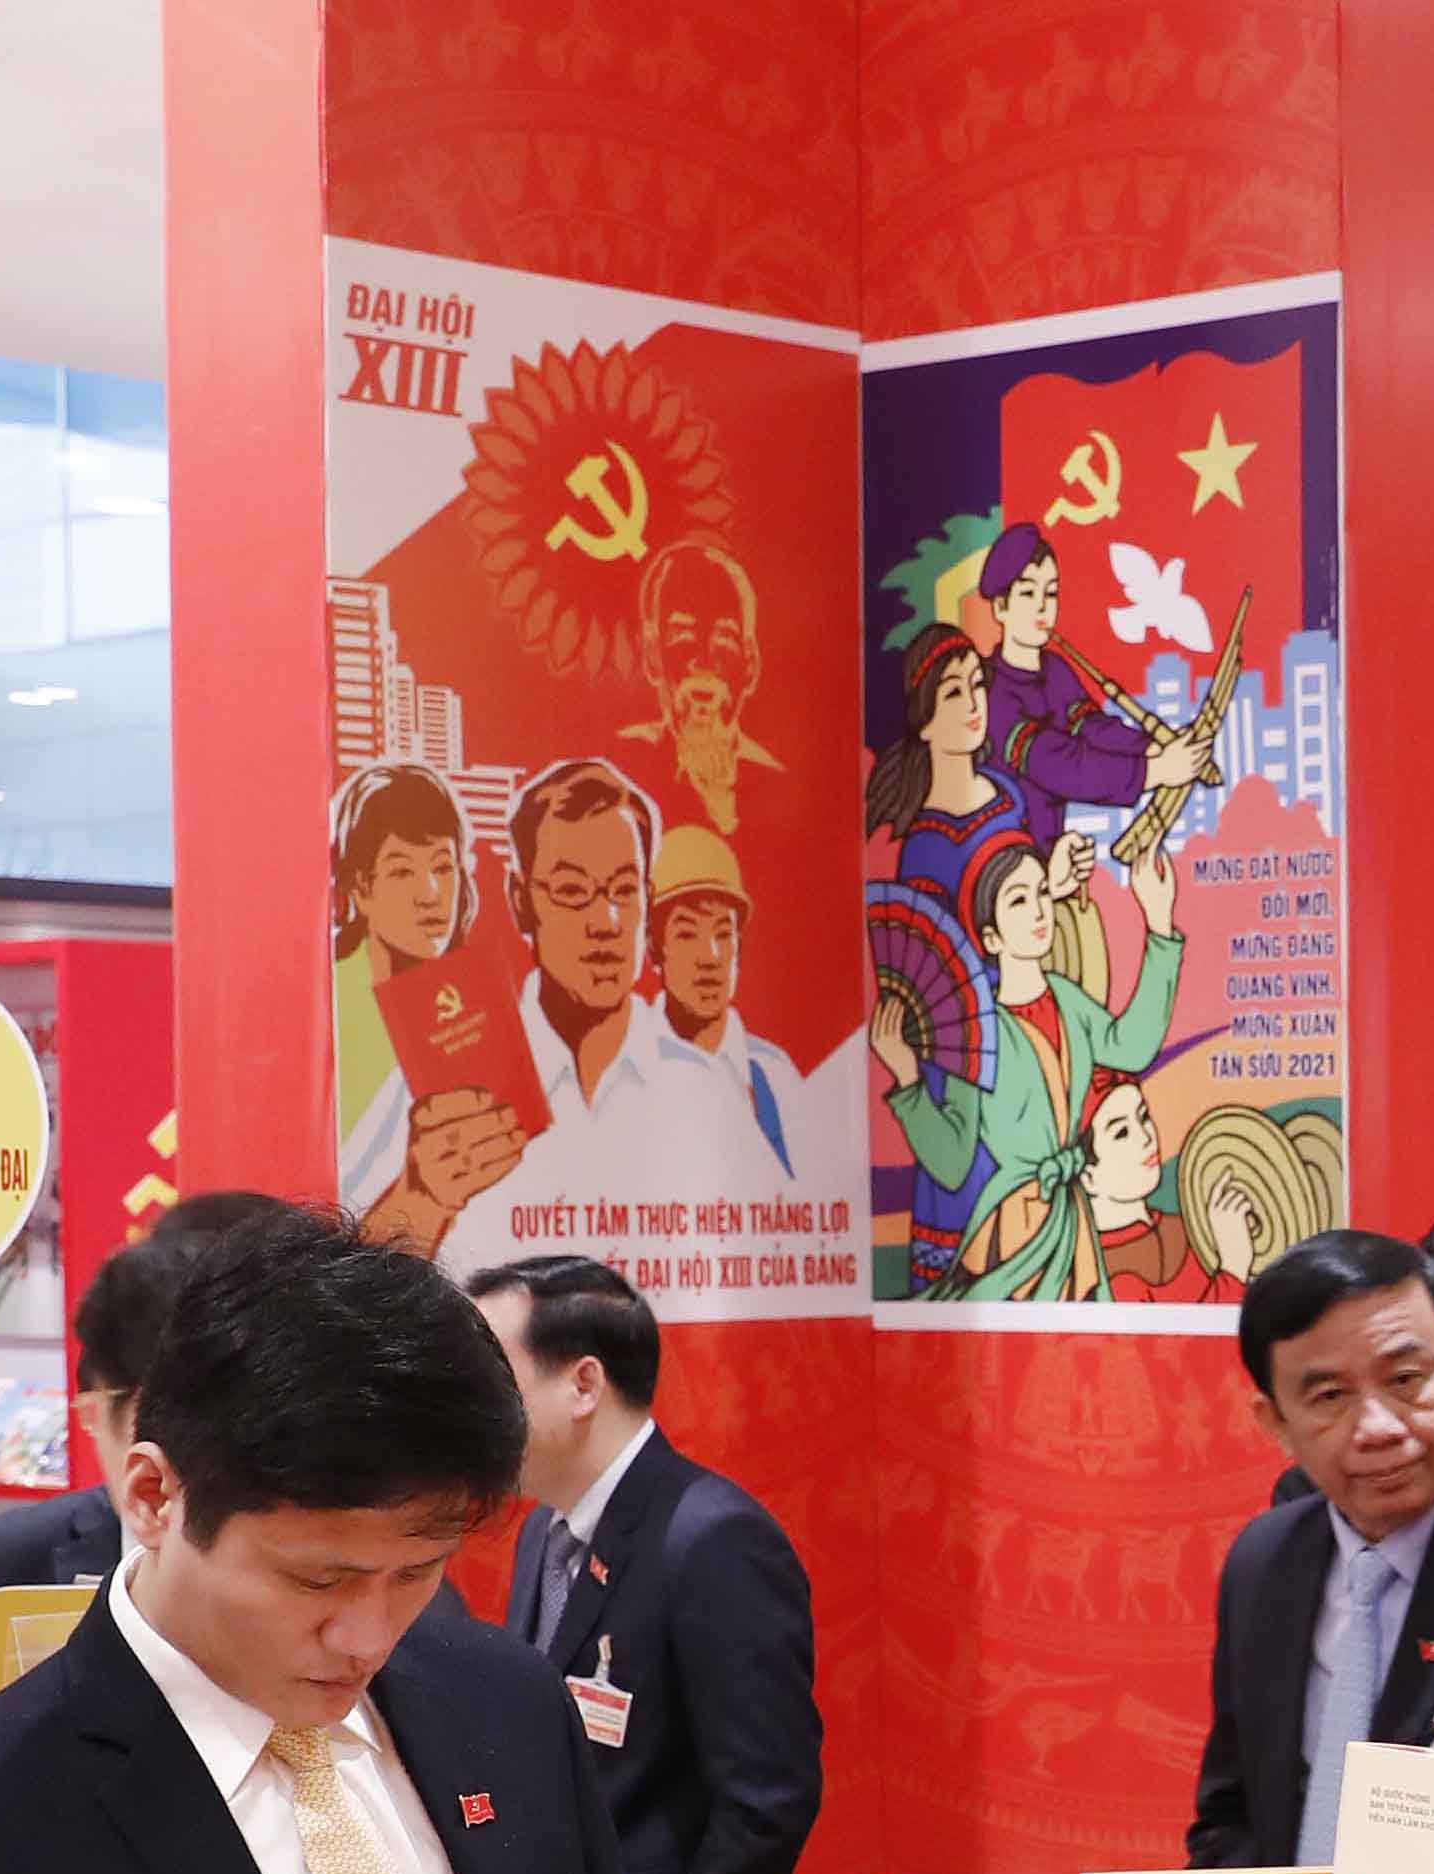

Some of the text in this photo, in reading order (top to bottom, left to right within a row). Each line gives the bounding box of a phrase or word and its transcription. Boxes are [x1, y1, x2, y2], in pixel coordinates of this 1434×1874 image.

[347, 283, 475, 344] ĐẠI HỘI
[338, 333, 468, 417] XIII
[1227, 975, 1284, 999] QUANG
[1289, 1053, 1334, 1077] 2021
[1, 1150, 28, 1201] ĐẠI
[511, 1193, 849, 1243] QUYẾT TÂM THỰC HIỆN THẮNG LỢI
[637, 1257, 670, 1297] ĐẠI
[679, 1251, 710, 1296] HỘI
[718, 1256, 751, 1288] XIII
[759, 1243, 797, 1287] CỦA
[803, 1241, 857, 1286] ĐẢNG
